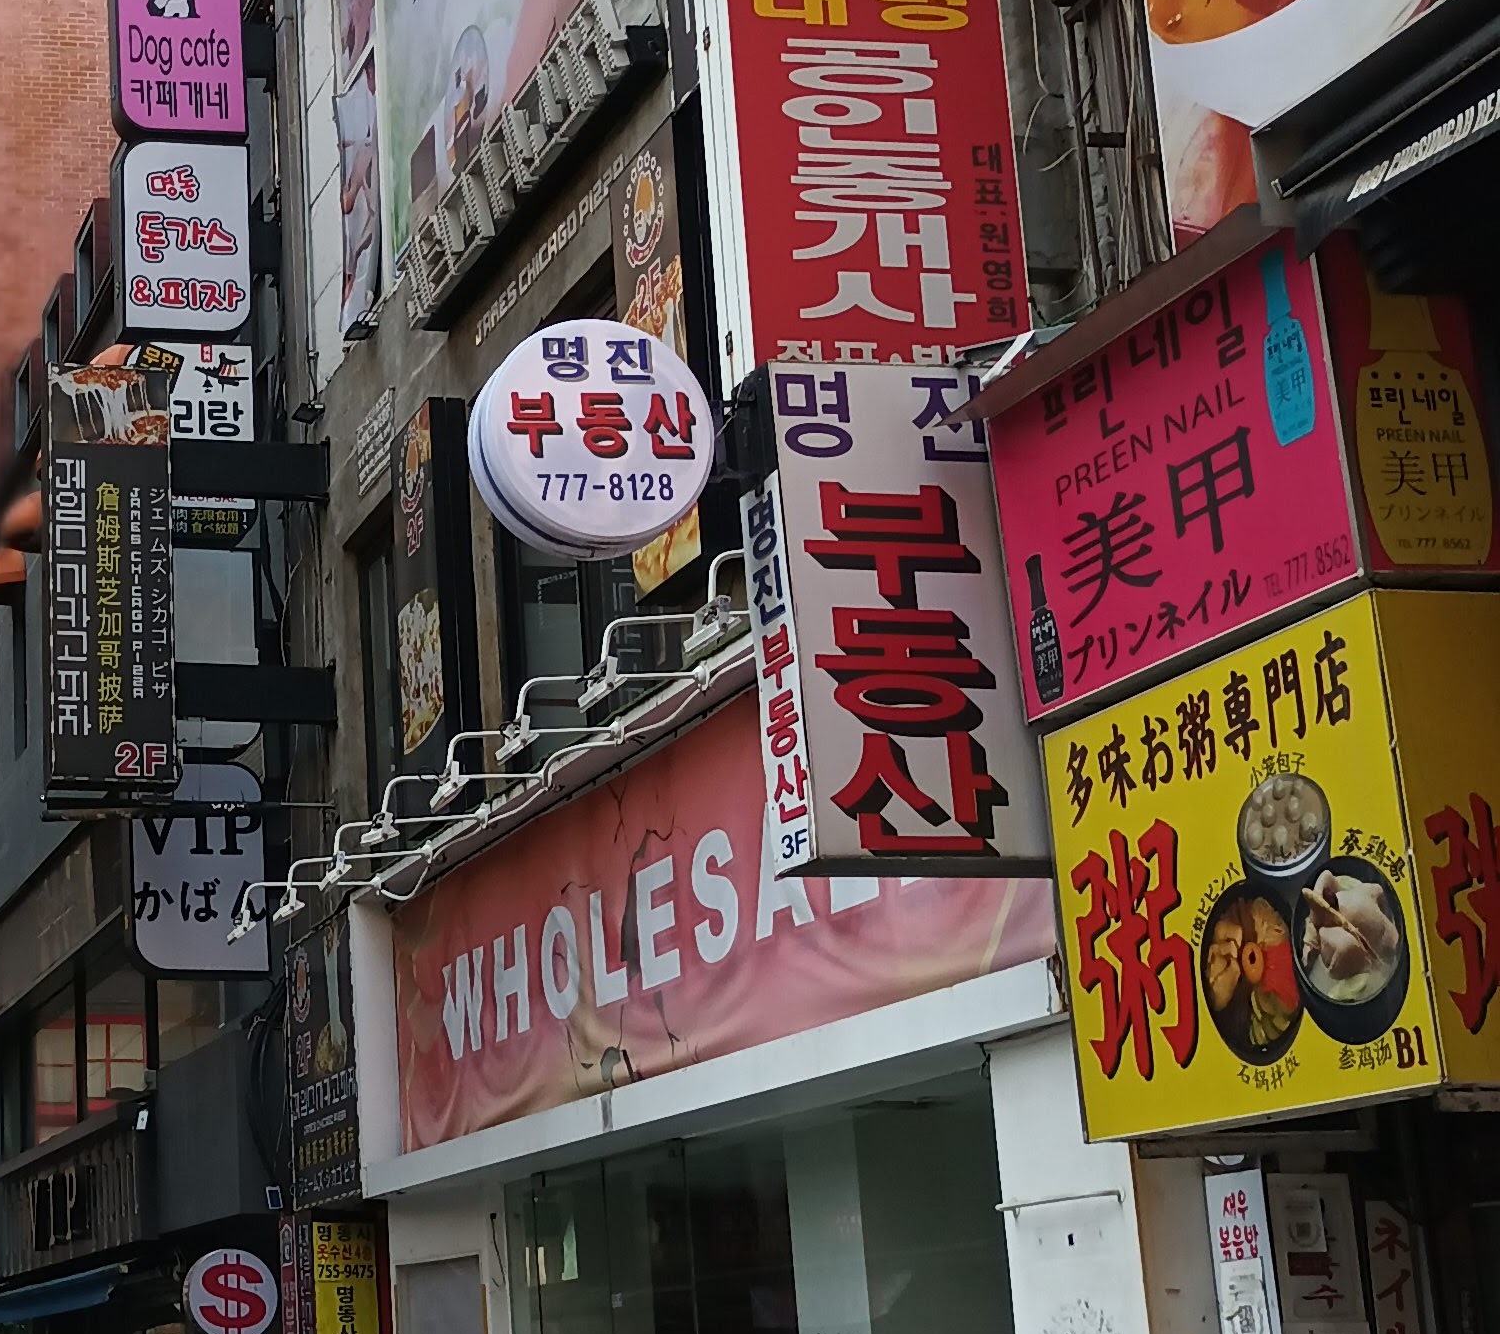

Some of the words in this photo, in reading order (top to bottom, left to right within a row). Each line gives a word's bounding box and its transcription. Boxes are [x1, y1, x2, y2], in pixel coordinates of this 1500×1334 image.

[128, 23, 173, 75] Dog
[180, 27, 231, 69] cafe
[129, 79, 229, 121] 카페개네
[146, 165, 200, 203] 명동
[779, 37, 977, 331] 공인중개사
[136, 212, 238, 264] 돈가스
[475, 280, 517, 347] JAMES
[518, 209, 578, 296] CHICAGO
[635, 256, 662, 323] 2F
[541, 336, 655, 384] 명진
[1041, 353, 1126, 441] 프린
[1128, 277, 1248, 369] 네일
[172, 399, 245, 438] 리랑
[506, 390, 699, 461] 부동산
[774, 370, 989, 464] 명진
[1054, 424, 1154, 507] PREEN
[1163, 377, 1246, 443] NAIL
[535, 472, 675, 502] 777-8128
[1380, 449, 1470, 497] 美甲
[129, 487, 142, 545] JAMES
[407, 508, 424, 558] 2F
[1059, 424, 1253, 629] 美甲
[130, 551, 143, 633] CHICAGO
[1066, 569, 1253, 686] プリンネイル
[803, 480, 1010, 859] 부동산
[759, 623, 809, 826] 부동산
[114, 740, 168, 777] 2F
[140, 816, 263, 857] VIP
[780, 829, 809, 861] 3F
[133, 877, 268, 923] かばん
[441, 828, 952, 1062] WHOLESA
[1069, 817, 1199, 1082] 粥
[1395, 1025, 1430, 1071] B1
[317, 1263, 374, 1280] 755-9475
